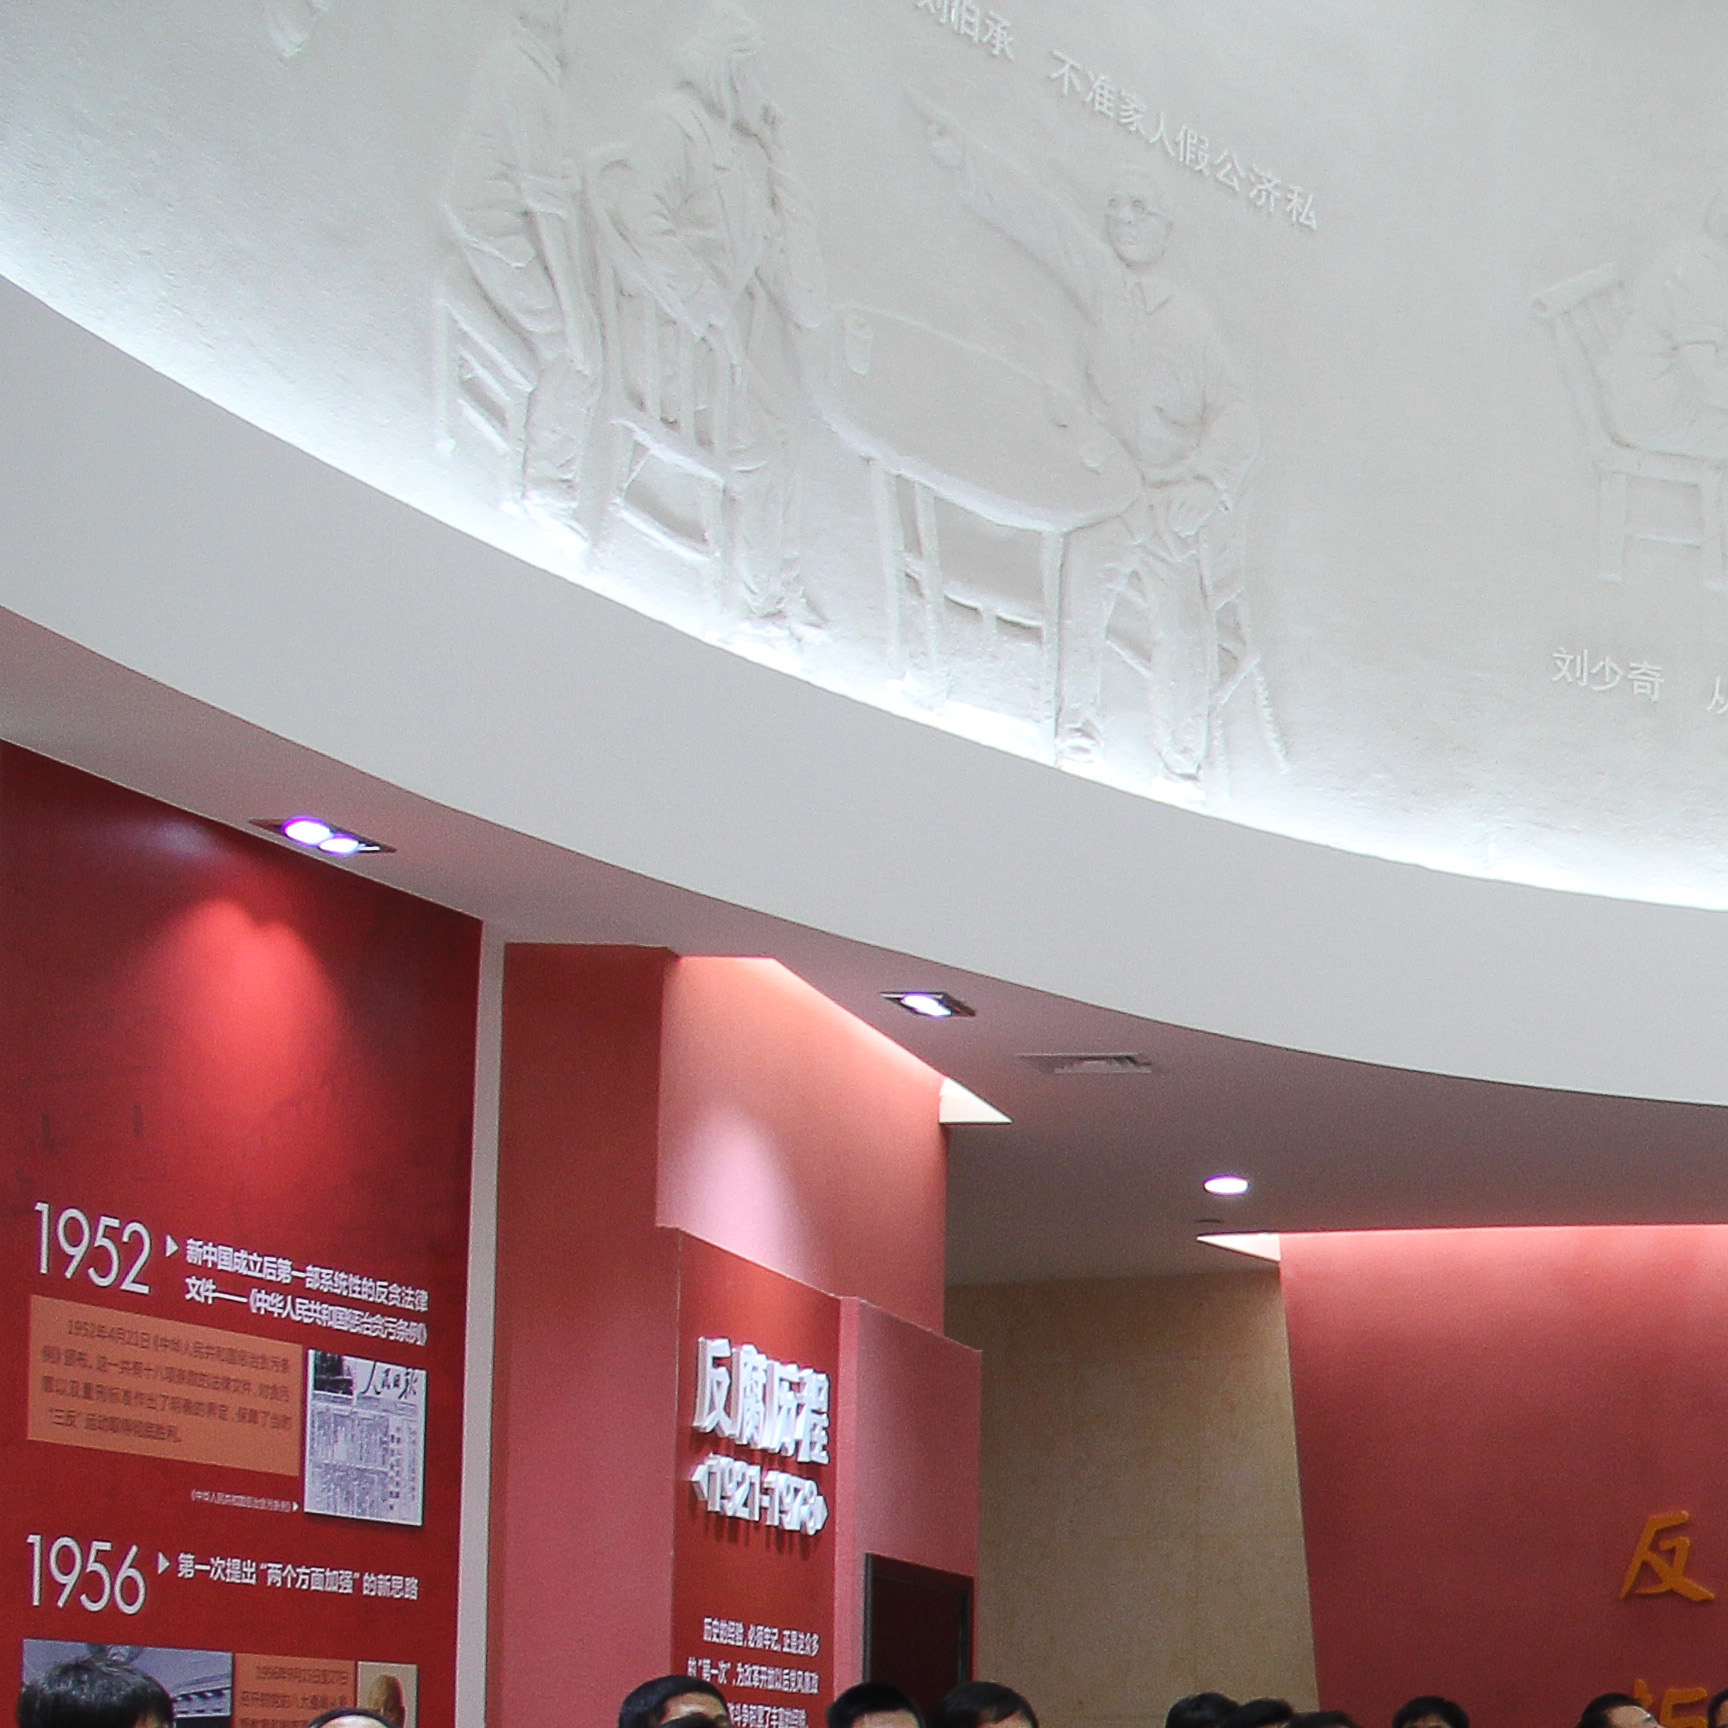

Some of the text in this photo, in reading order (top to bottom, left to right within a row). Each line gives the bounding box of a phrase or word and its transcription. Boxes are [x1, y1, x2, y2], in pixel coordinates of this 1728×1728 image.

[1047, 48, 1319, 230] 不准家人假公济私
[1551, 646, 1665, 702] 刘少奇
[33, 1200, 152, 1295] 1952
[691, 1335, 831, 1466] 反腐历程
[26, 1533, 148, 1616] 1956
